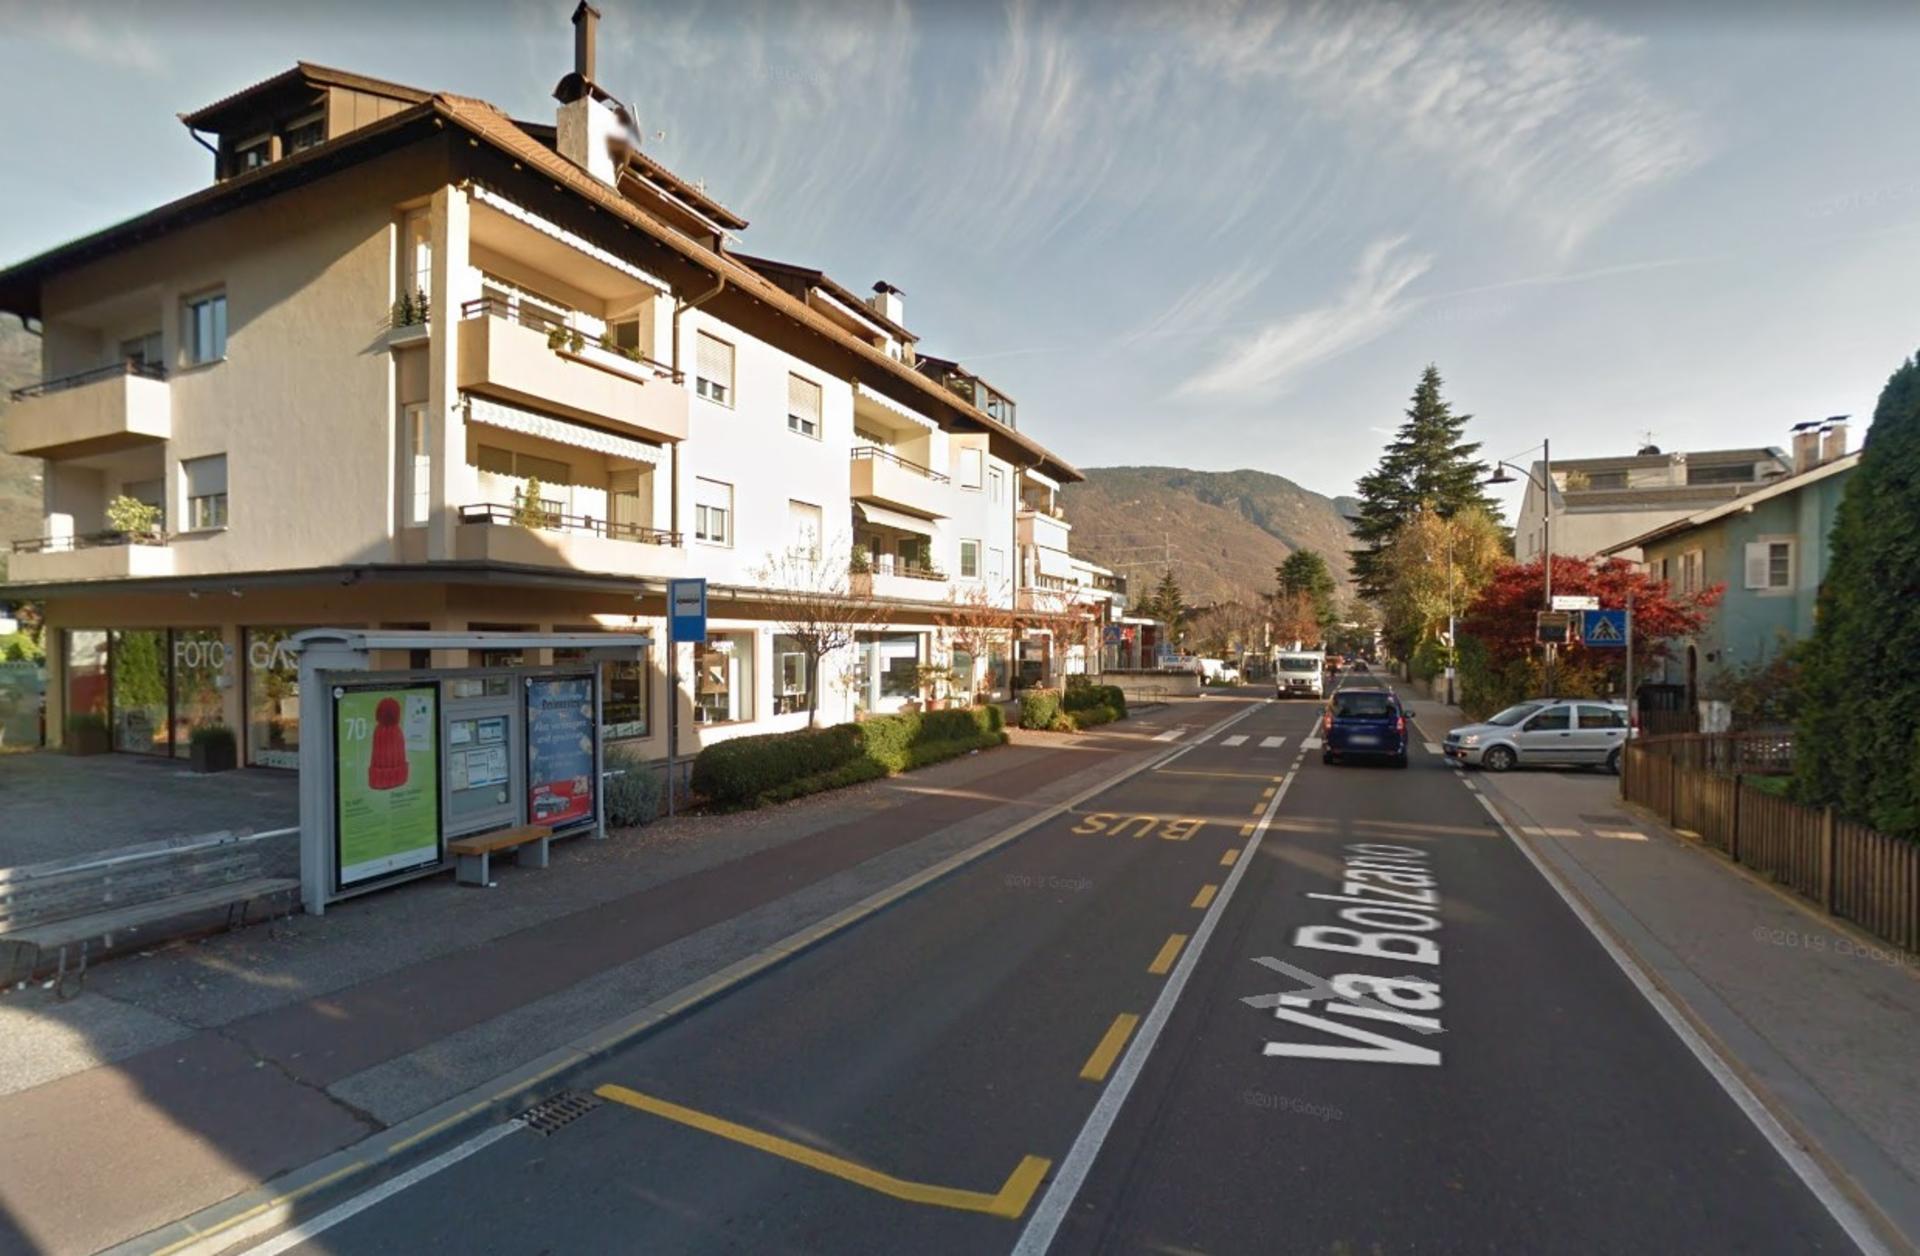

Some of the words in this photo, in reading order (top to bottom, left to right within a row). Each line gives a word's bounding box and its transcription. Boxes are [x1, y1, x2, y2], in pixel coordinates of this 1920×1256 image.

[174, 641, 224, 668] FOTO
[344, 717, 367, 741] 70
[1071, 813, 1207, 840] BUS
